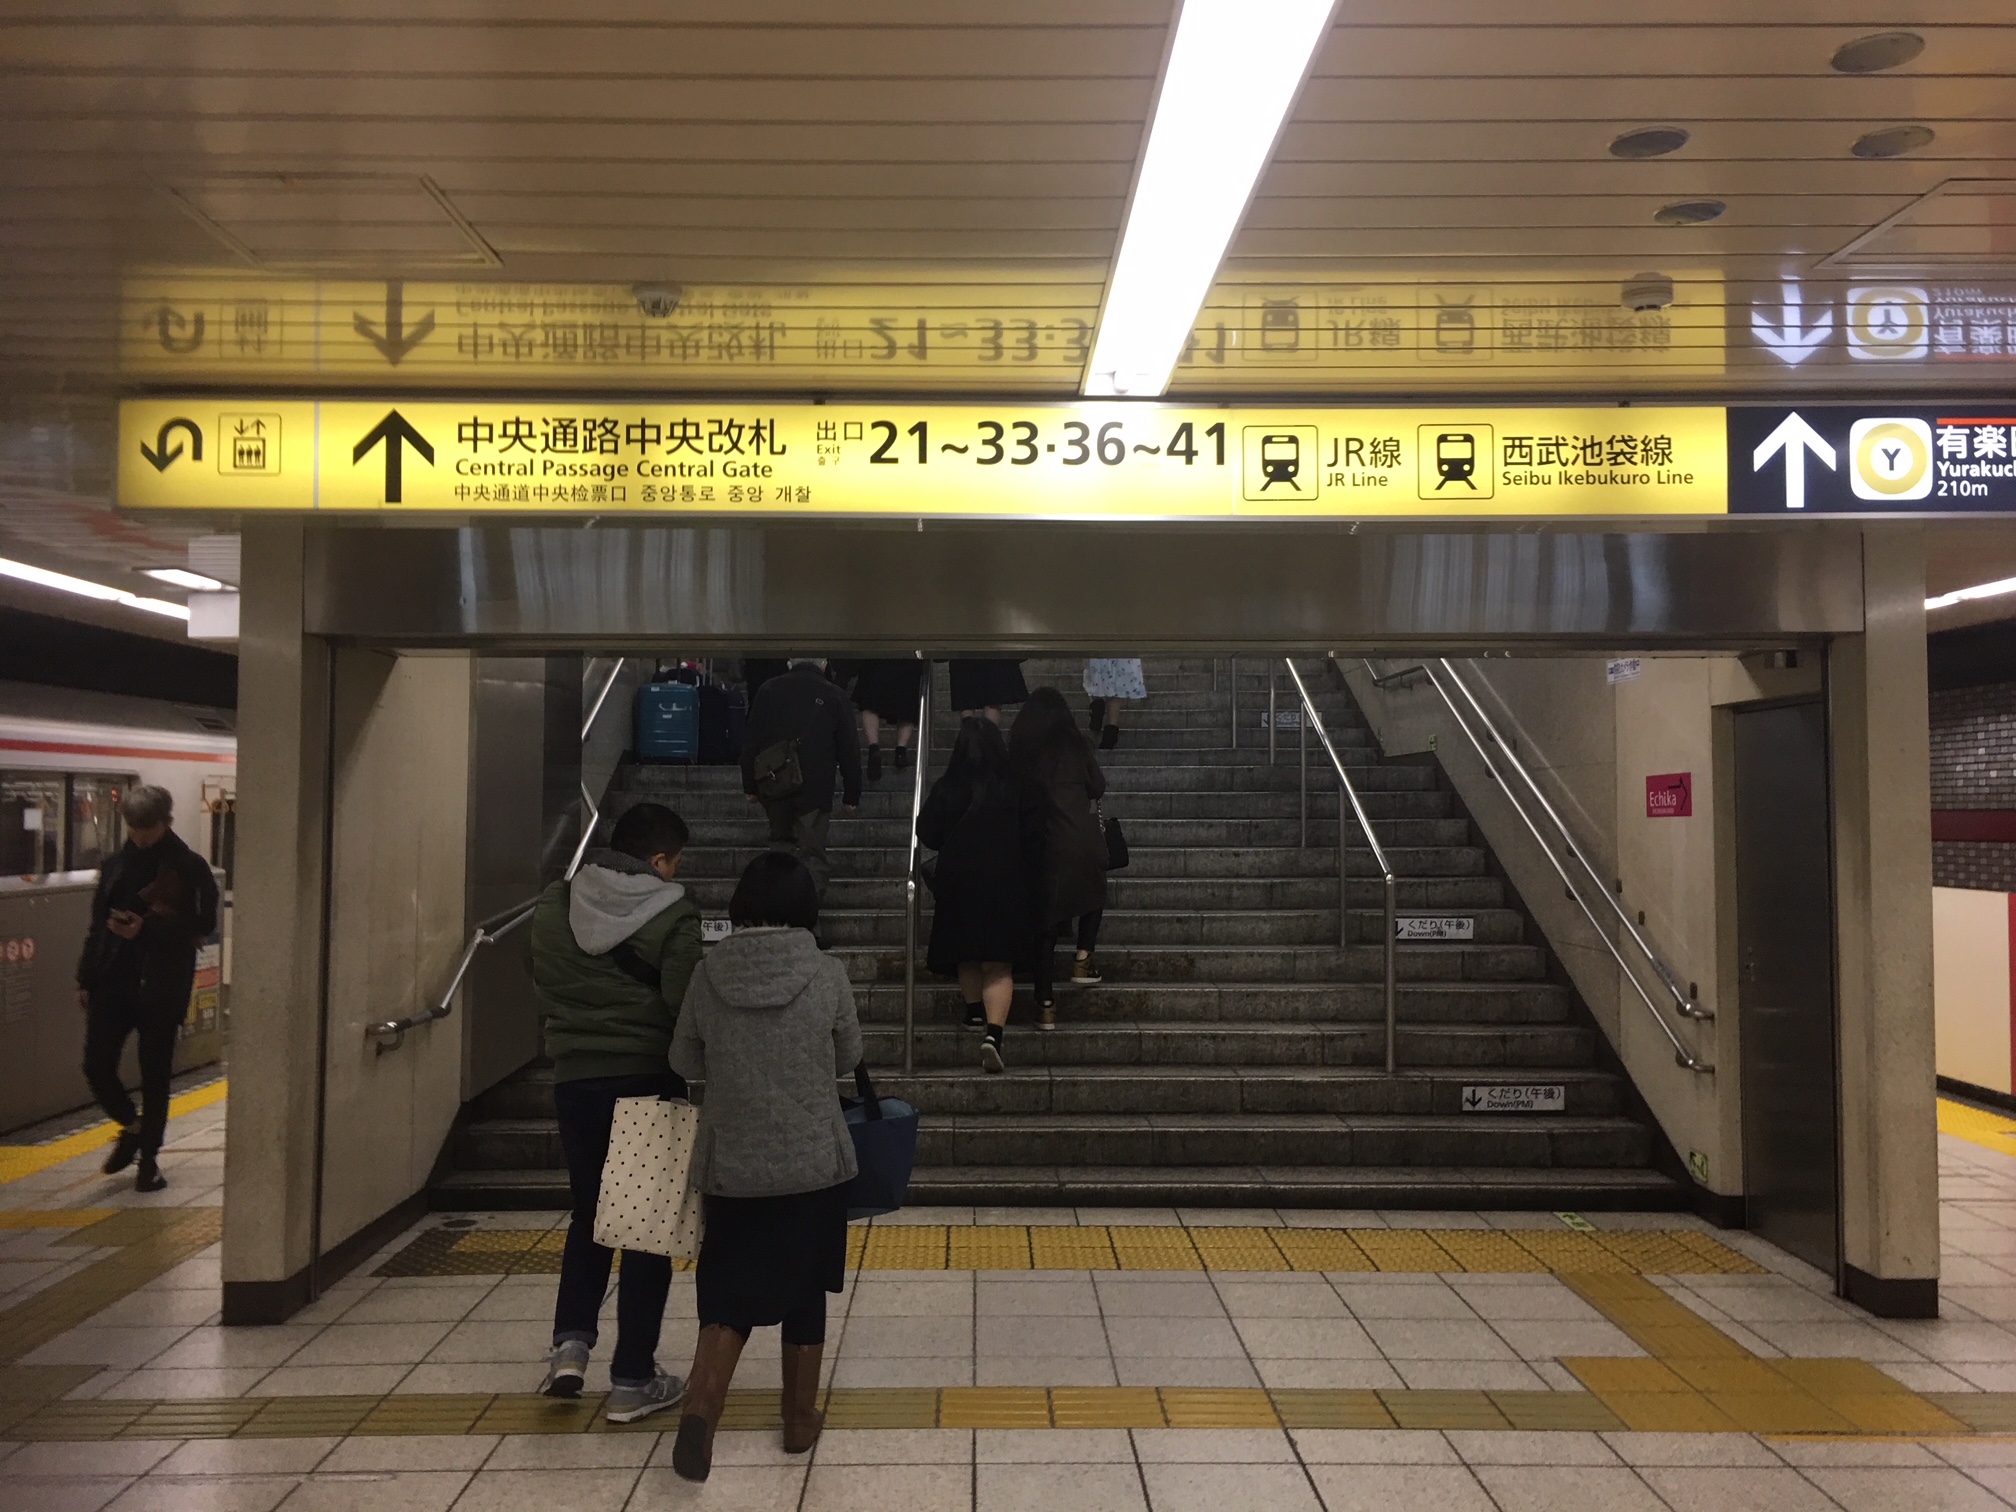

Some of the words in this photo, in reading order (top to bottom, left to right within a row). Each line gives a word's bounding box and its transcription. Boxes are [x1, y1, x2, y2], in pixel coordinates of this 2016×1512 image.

[458, 416, 786, 455] 中央通路中央改札
[817, 419, 863, 441] 出口
[817, 443, 841, 454] Exit
[1327, 436, 1402, 468] JR線
[1502, 435, 1673, 467] 西武池袋線
[1936, 425, 2016, 459] 有楽
[456, 458, 534, 476] Central
[543, 459, 629, 481] Passage
[636, 459, 714, 478] Central
[722, 460, 773, 478] Gate
[1881, 448, 1901, 471] Y
[1936, 460, 2016, 478] Yurakuc
[1327, 472, 1345, 487] JR
[1352, 472, 1388, 487] Line
[1502, 471, 1552, 486] Seibu
[1558, 470, 1650, 486] Ikebukuro
[1657, 470, 1694, 485] Line
[1937, 480, 1988, 497] 210m
[454, 483, 627, 503] 中央通道中央检票口
[641, 485, 715, 503] 중앙통로
[728, 485, 764, 503] 중앙
[776, 486, 812, 503] 개찰
[1650, 790, 1676, 807] Echika
